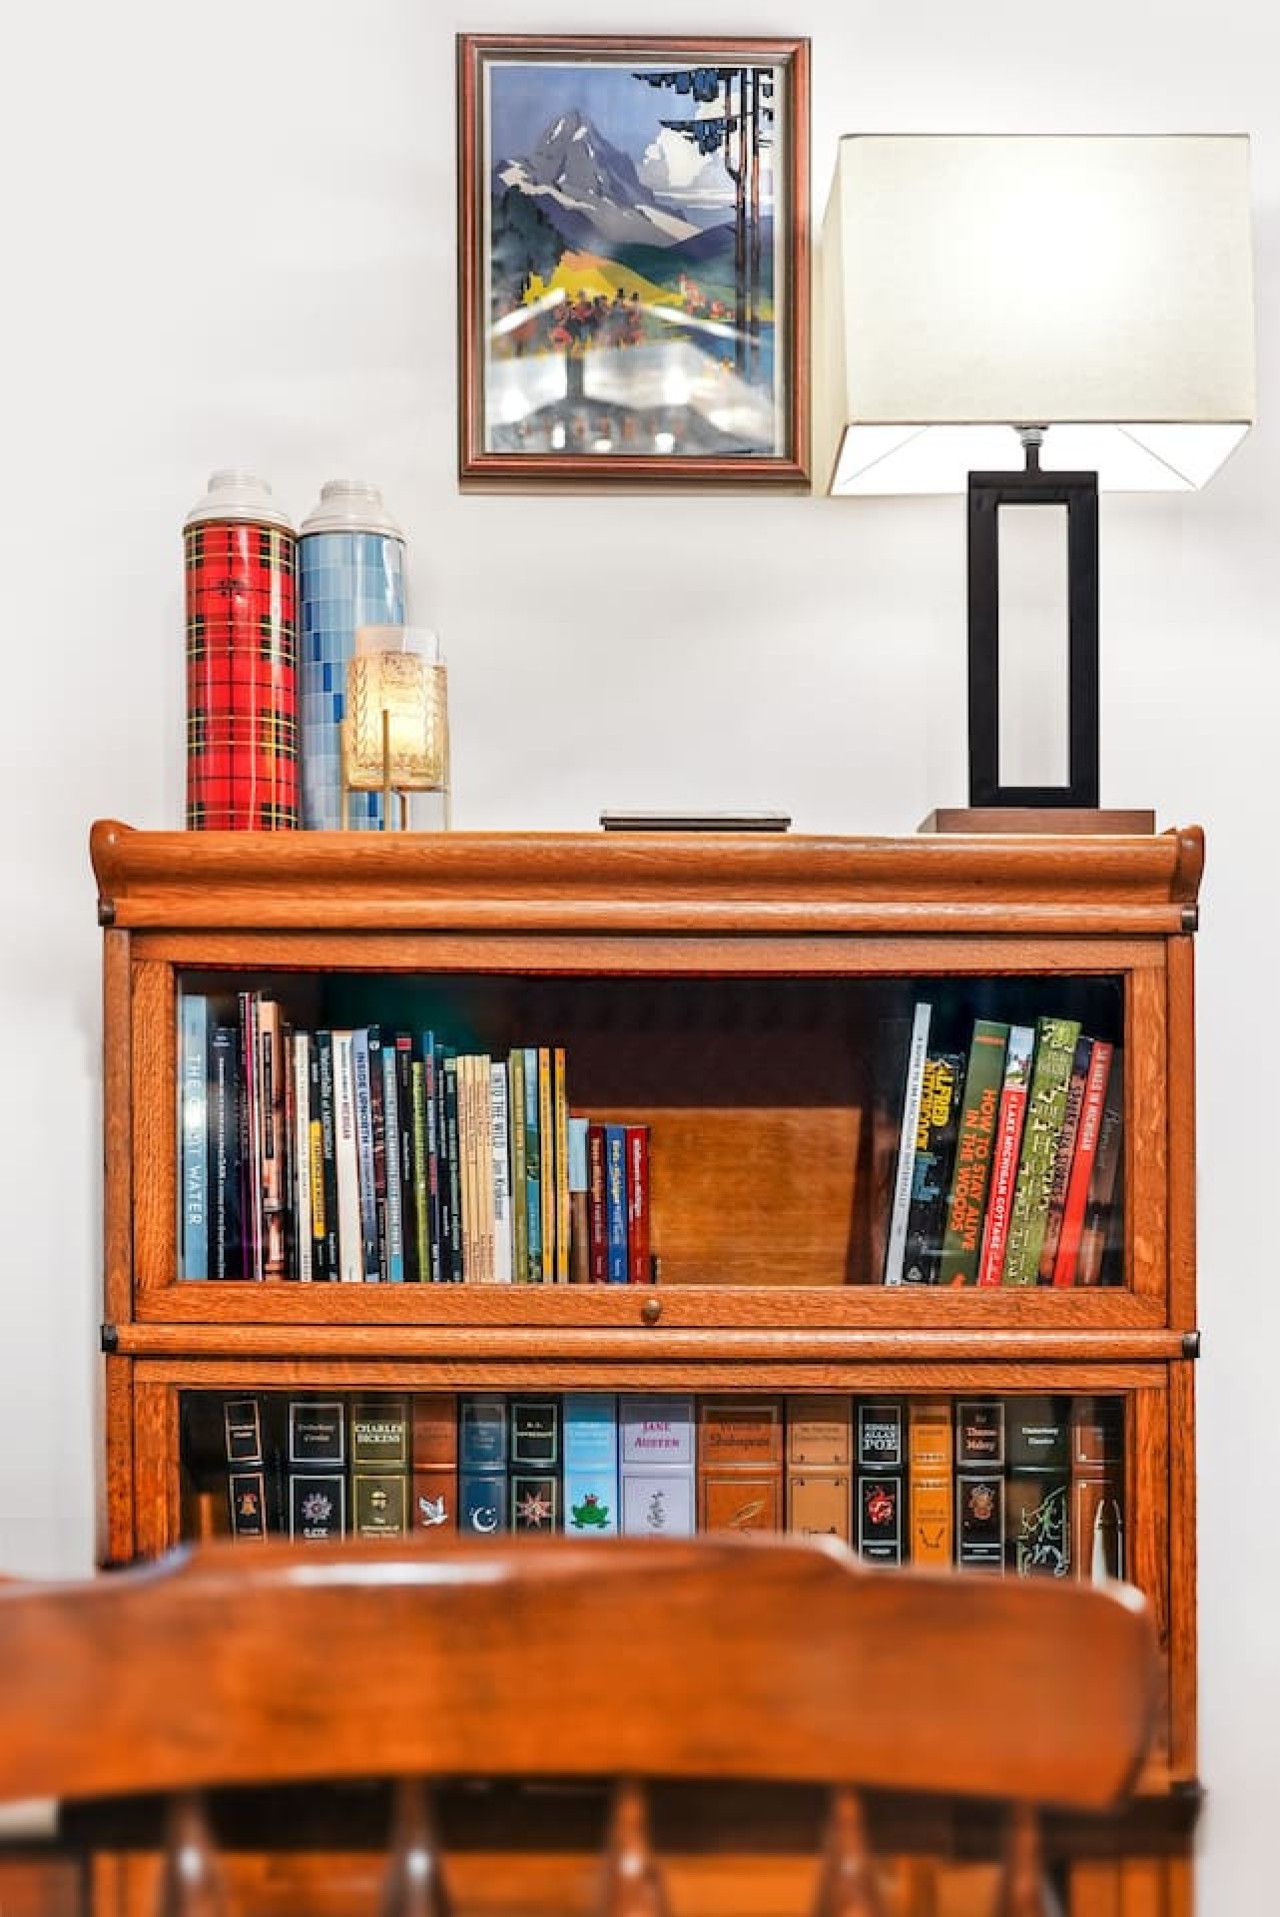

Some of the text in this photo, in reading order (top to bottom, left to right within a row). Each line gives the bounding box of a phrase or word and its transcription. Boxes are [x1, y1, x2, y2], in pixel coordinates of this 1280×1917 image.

[188, 1054, 201, 1087] THE
[356, 1051, 367, 1088] INSIDE
[493, 1101, 505, 1118] THE
[932, 1063, 954, 1127] ALFRED
[358, 1091, 369, 1145] UPNORTH
[1006, 1104, 1018, 1128] LAKE
[494, 1123, 505, 1149] WILD
[951, 1110, 979, 1231] IN THE WOODS
[963, 1089, 995, 1251] HOW TO STAY ALIVE
[998, 1131, 1014, 1193] MICHIGAN
[188, 1165, 202, 1226] WATER
[988, 1196, 1005, 1249] COTTAGE
[355, 1423, 402, 1433] CHARLES
[357, 1434, 400, 1443] DICKENS
[634, 1437, 680, 1449] AUSTEN
[641, 1422, 672, 1433] JANE
[864, 1440, 898, 1450] POE
